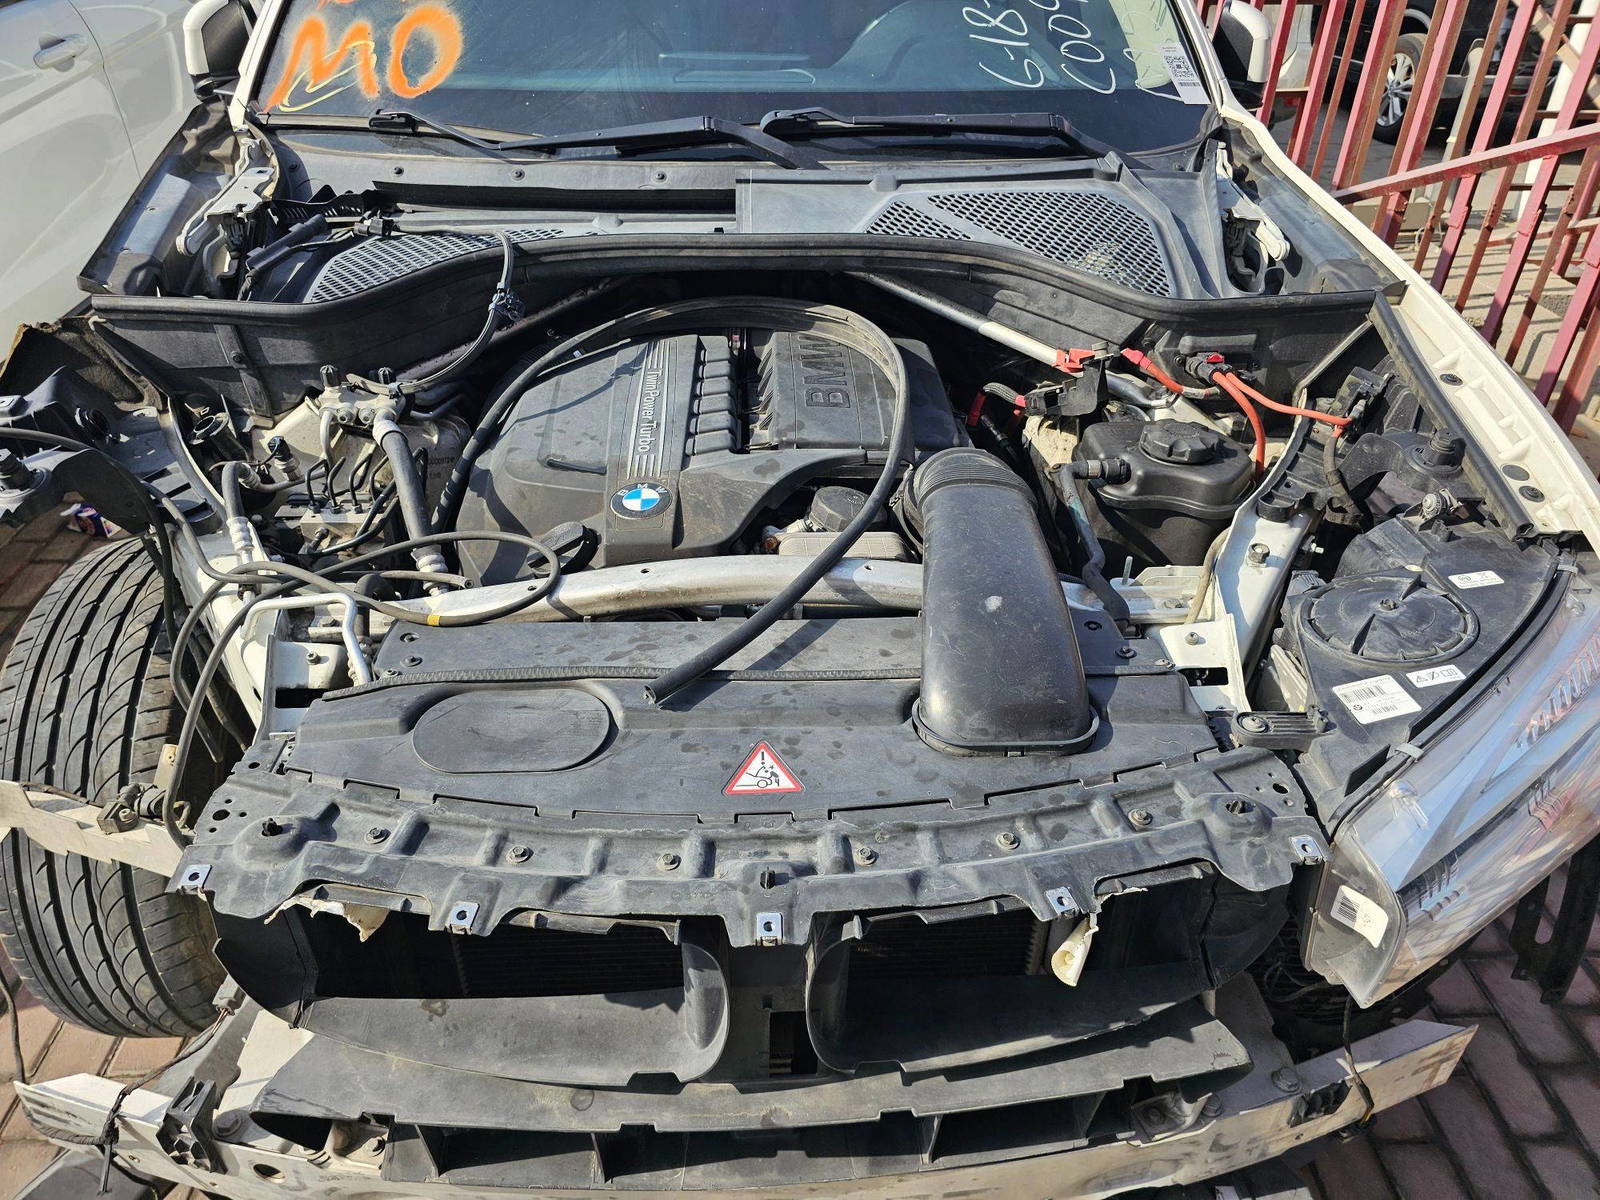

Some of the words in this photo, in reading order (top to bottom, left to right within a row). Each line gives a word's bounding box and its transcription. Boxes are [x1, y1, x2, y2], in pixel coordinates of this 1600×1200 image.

[798, 336, 851, 408] BMW
[642, 369, 662, 420] TwinPower
[638, 420, 657, 452] Turbo
[617, 483, 668, 496] BMW
